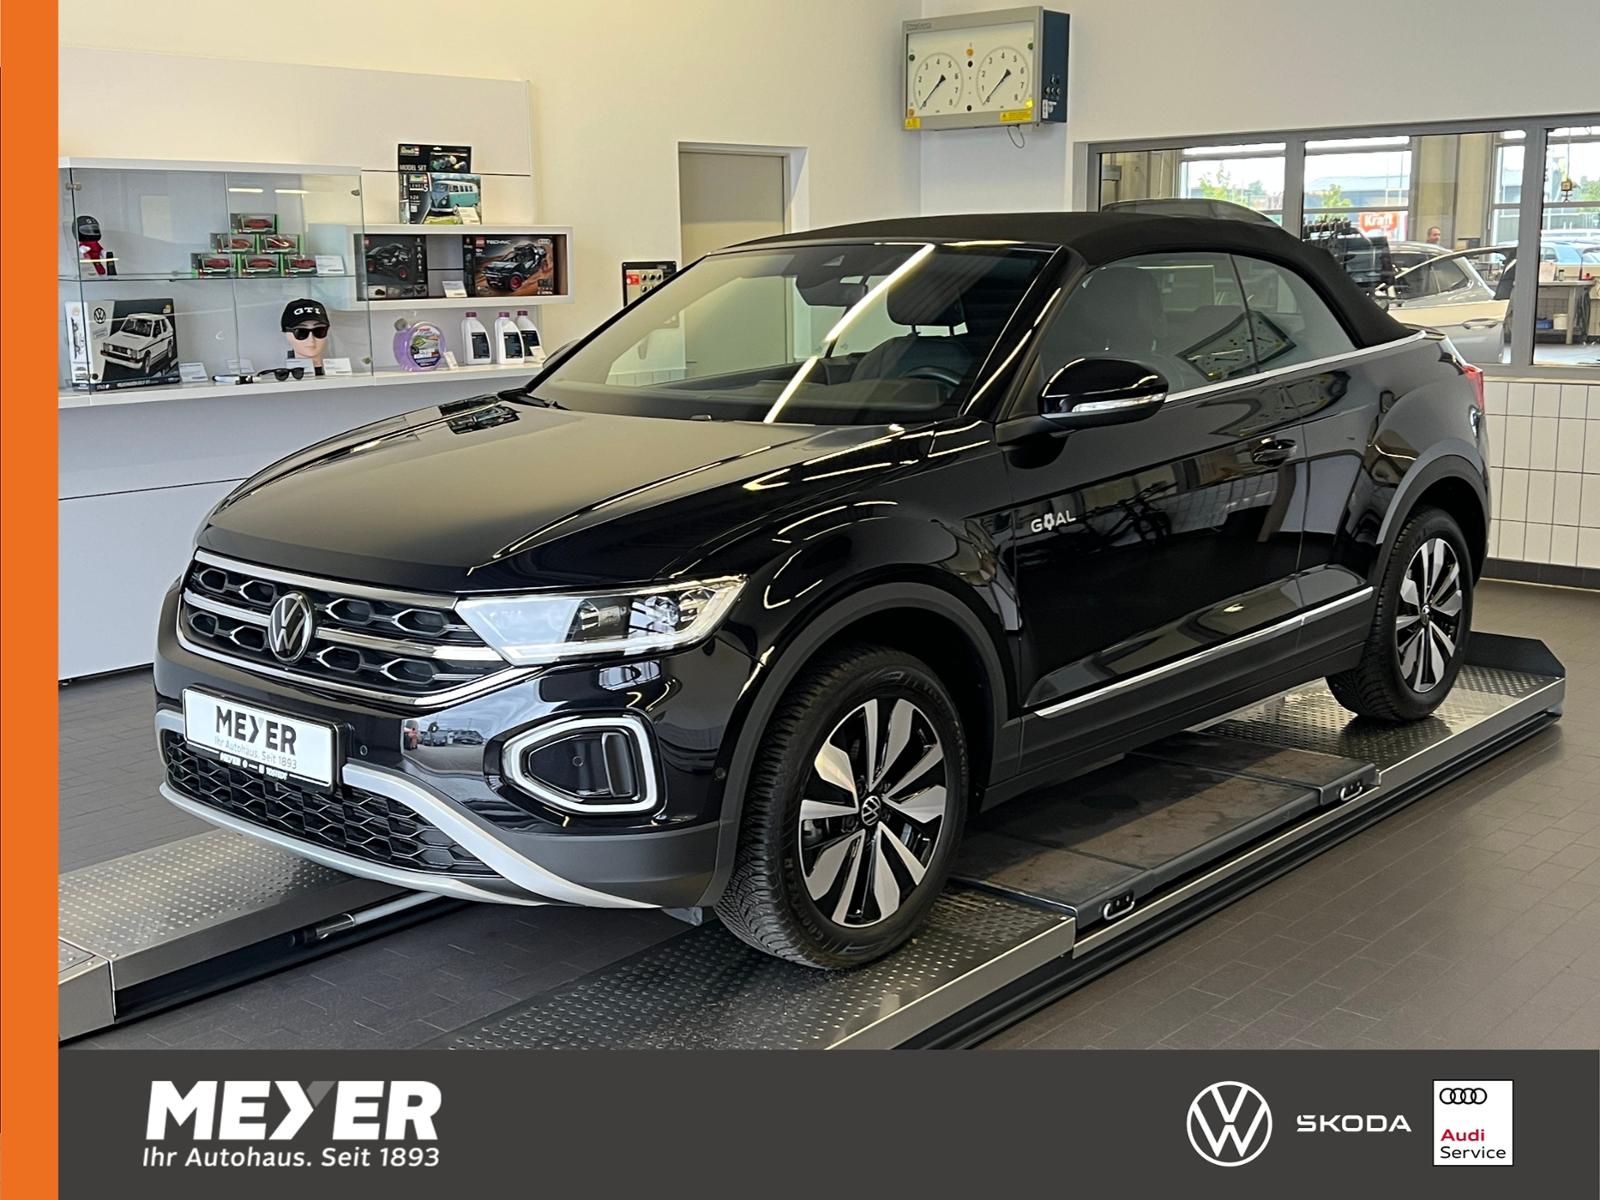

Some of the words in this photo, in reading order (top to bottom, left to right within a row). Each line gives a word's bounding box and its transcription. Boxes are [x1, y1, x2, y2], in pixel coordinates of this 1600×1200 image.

[1364, 213, 1392, 226] Kraft
[293, 307, 321, 316] GTI
[1031, 510, 1077, 533] GOAL
[215, 705, 297, 756] MEYER
[261, 750, 278, 765] Seit
[278, 755, 297, 770] 1893
